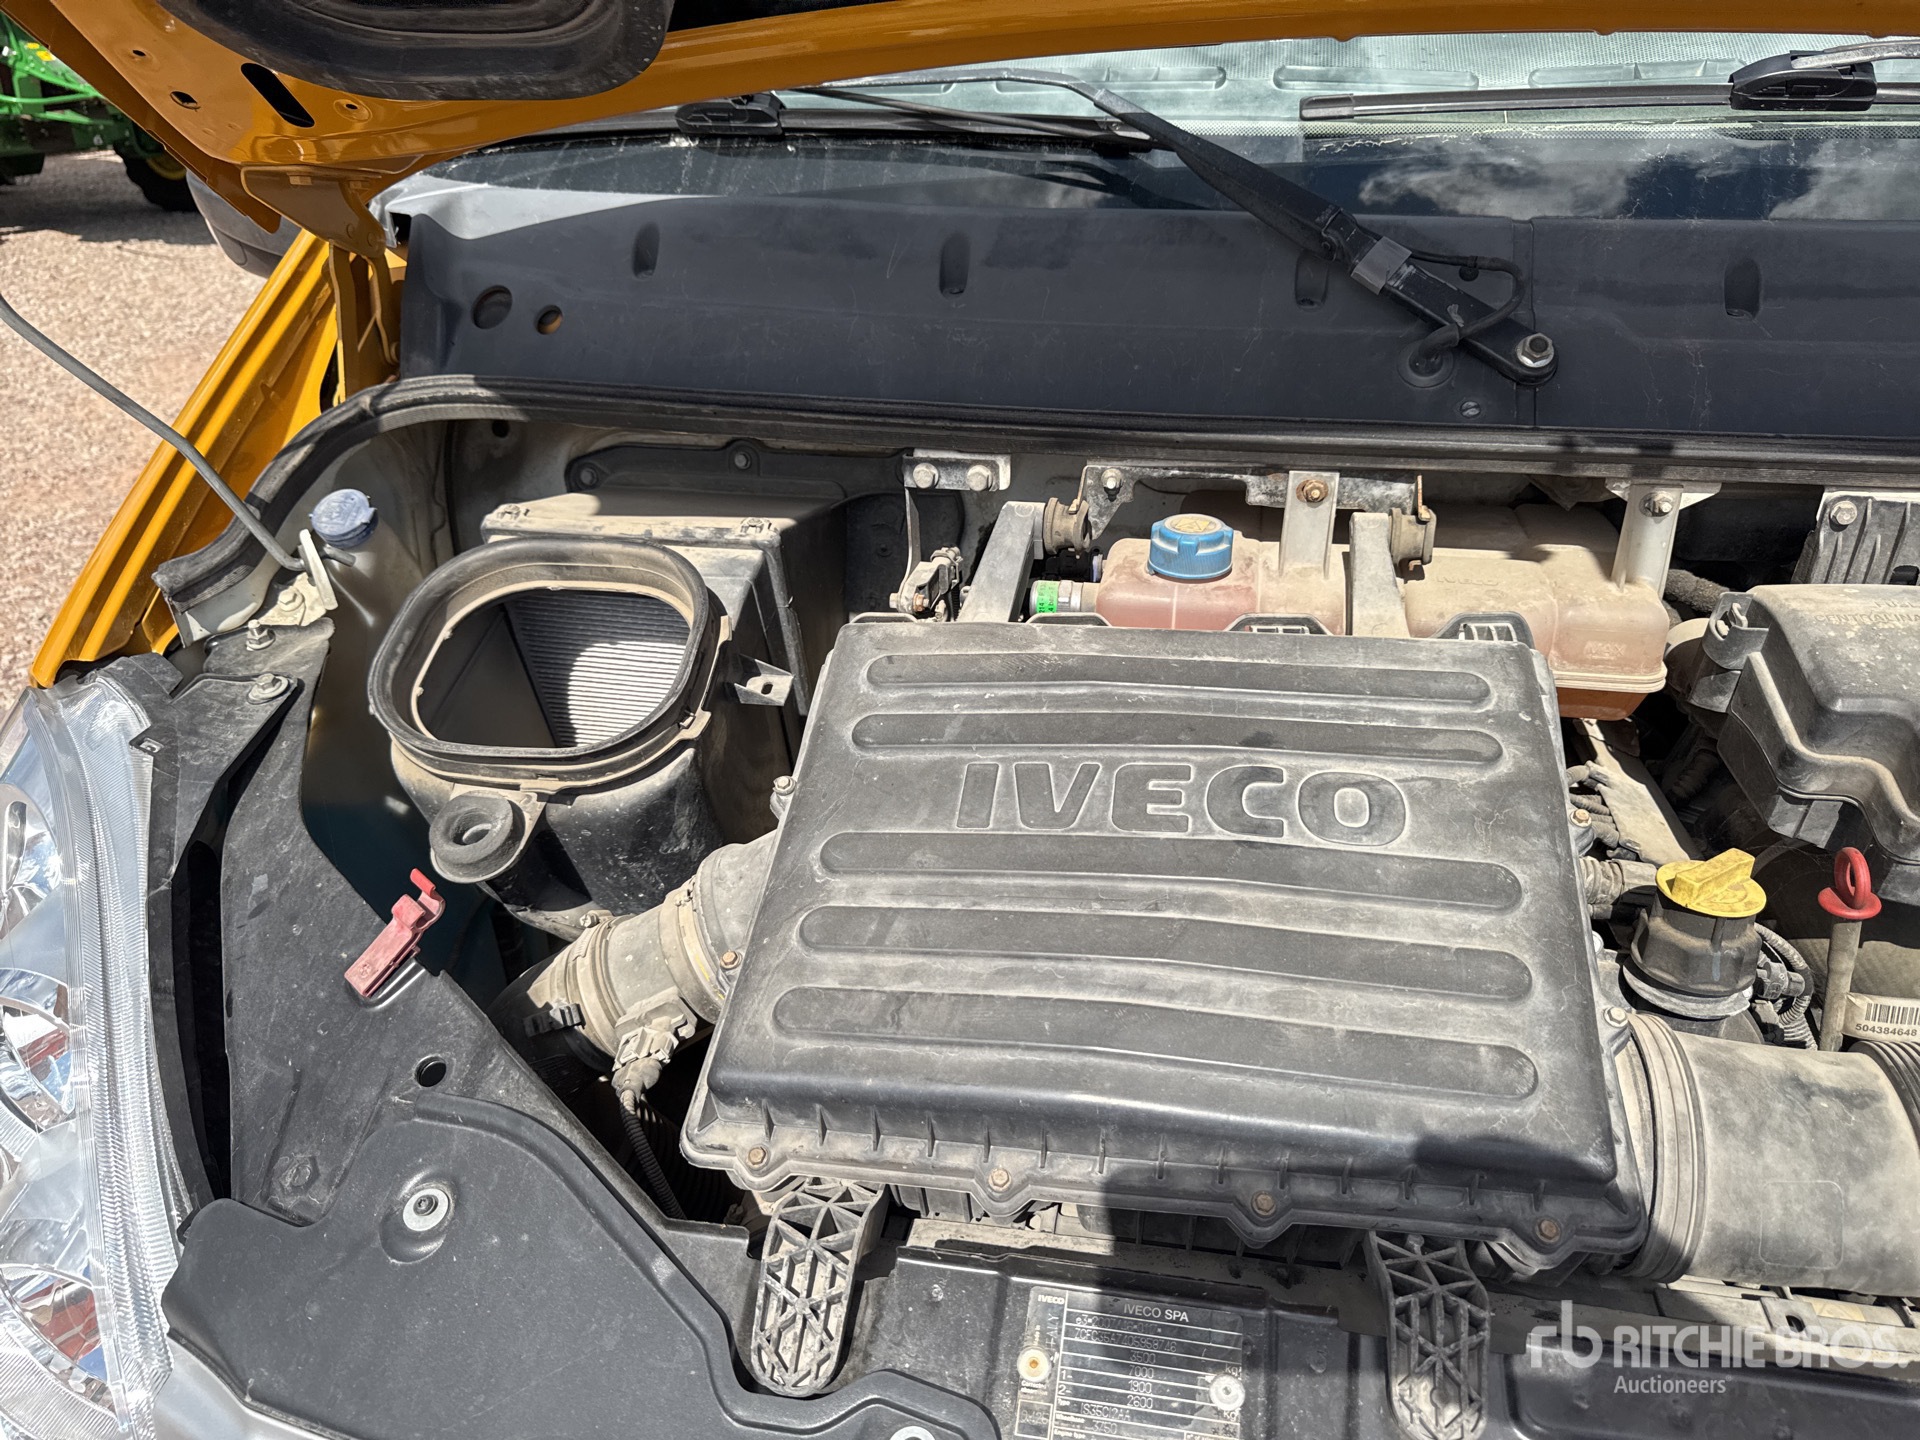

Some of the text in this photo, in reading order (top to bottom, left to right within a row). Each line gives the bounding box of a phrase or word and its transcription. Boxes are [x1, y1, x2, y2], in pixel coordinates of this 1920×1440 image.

[956, 763, 1407, 847] IVECO
[1855, 1023, 1918, 1036] 504384648
[1038, 1294, 1065, 1305] IVECO
[1123, 1303, 1190, 1323] IVECO SPA
[1129, 1350, 1157, 1366] 3500
[1128, 1364, 1155, 1379] 7000
[1128, 1379, 1153, 1395] 1900
[1127, 1394, 1153, 1410] 2600
[1092, 1419, 1118, 1435] 3750
